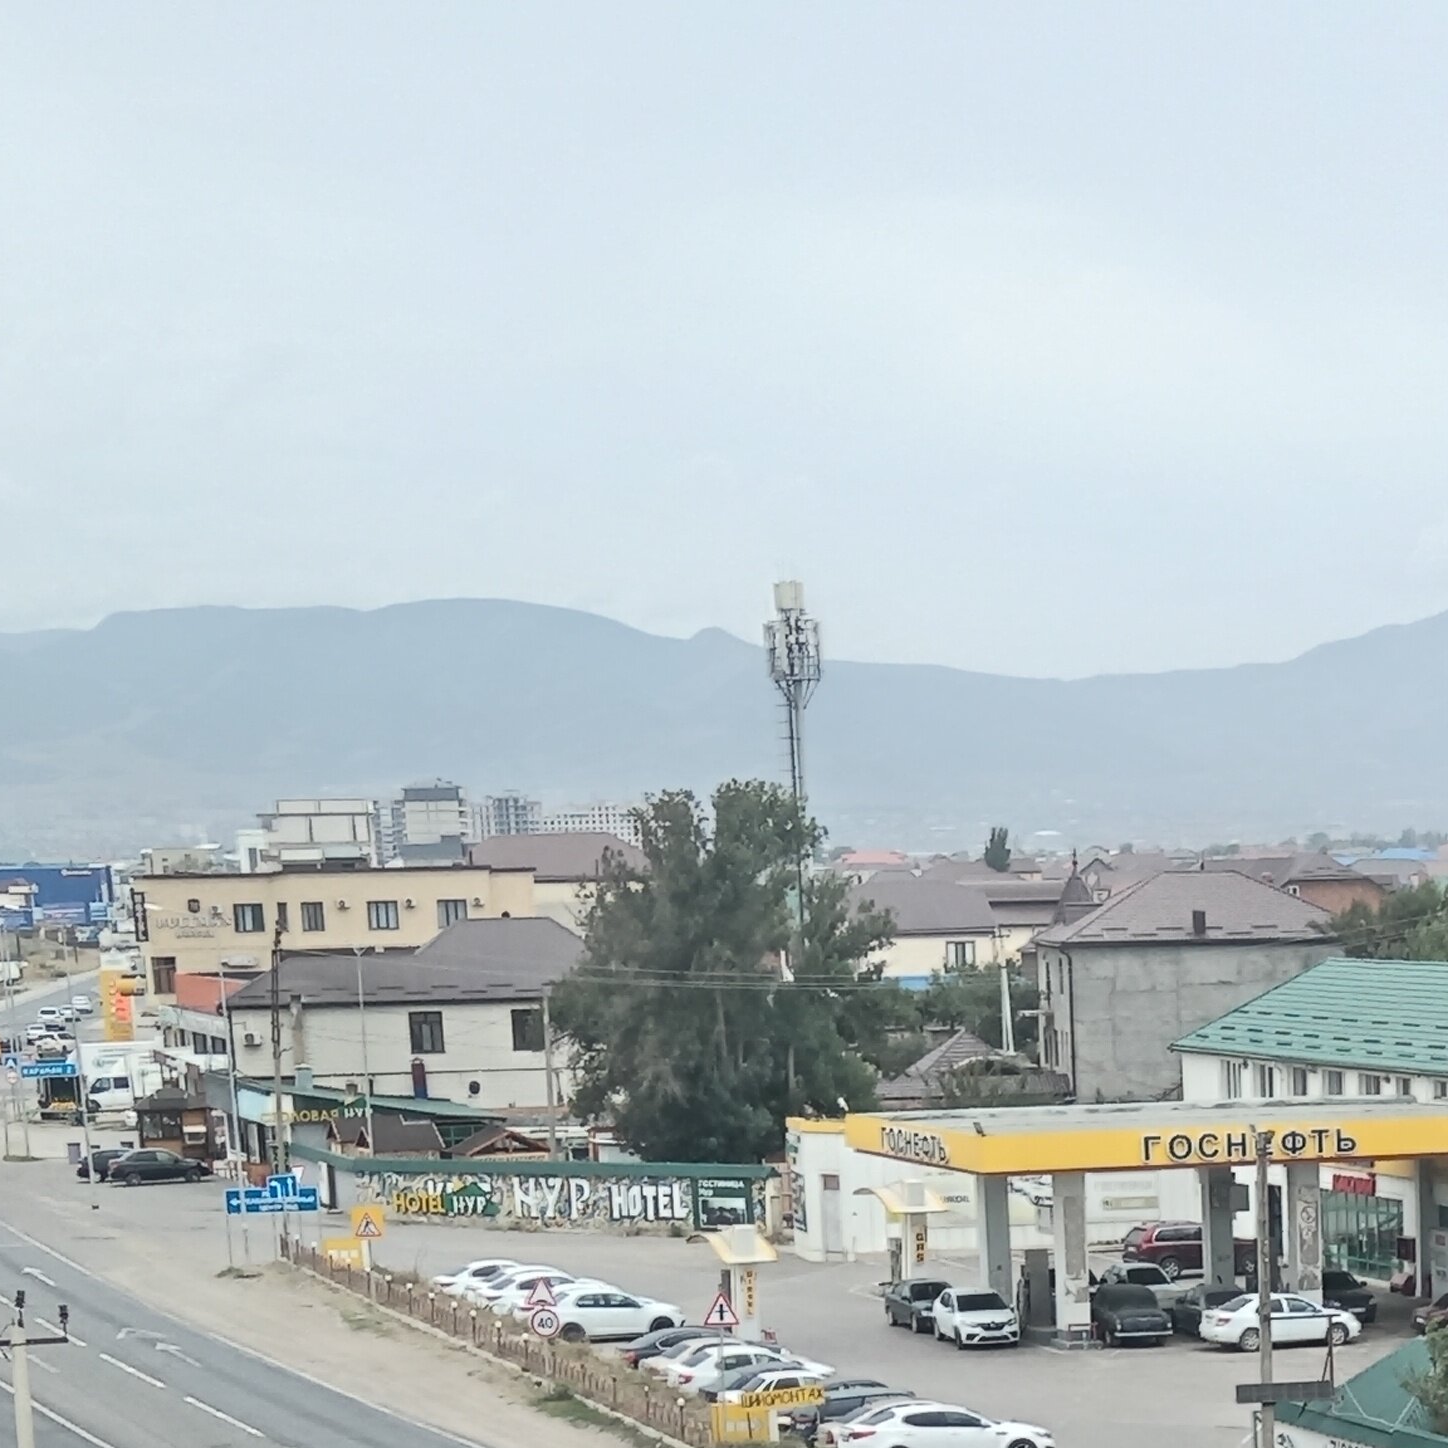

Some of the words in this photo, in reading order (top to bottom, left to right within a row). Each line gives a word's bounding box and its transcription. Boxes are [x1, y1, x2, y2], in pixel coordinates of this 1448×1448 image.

[393, 1190, 446, 1216] HOTEL
[610, 1182, 690, 1221] HOTEL
[537, 1316, 553, 1329] 40
